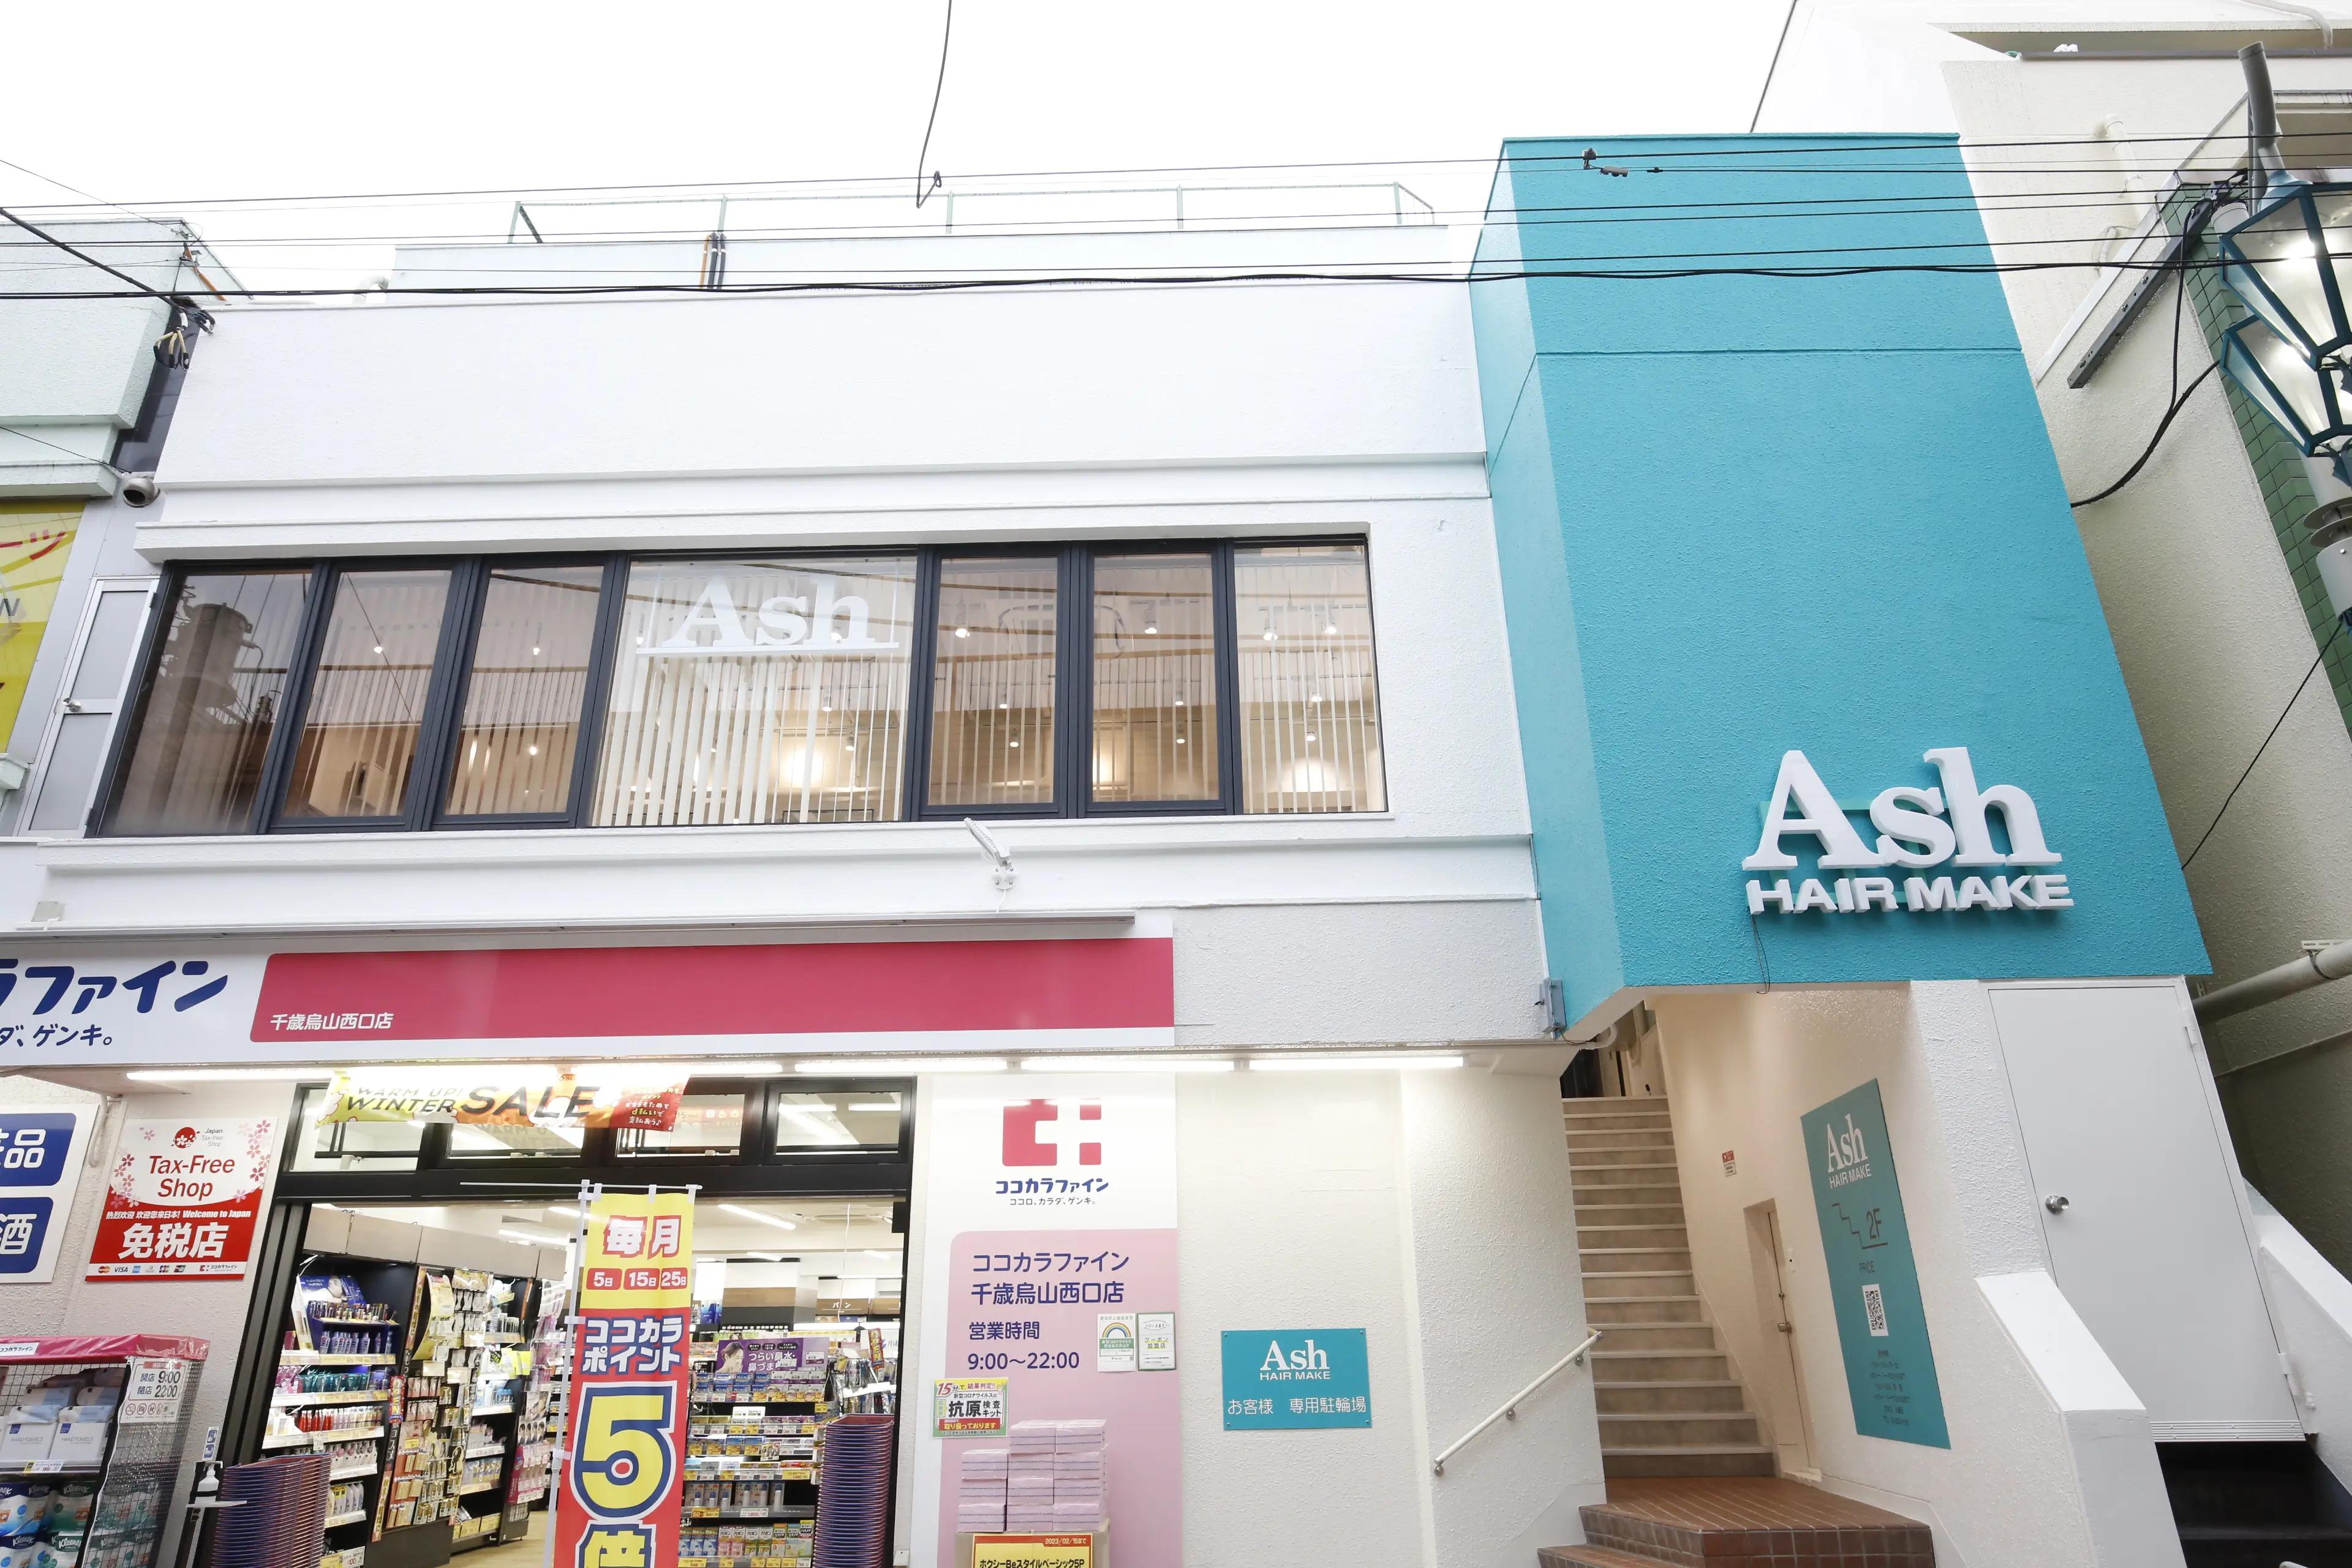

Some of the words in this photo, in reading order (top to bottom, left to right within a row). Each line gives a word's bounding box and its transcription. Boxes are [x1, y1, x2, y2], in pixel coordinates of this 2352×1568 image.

[662, 574, 876, 647] Ash
[1742, 746, 2063, 870] Ash
[1746, 876, 1899, 915] HAIR
[1904, 874, 2075, 911] MAKE
[270, 1012, 394, 1031] 千歳烏山西口店
[358, 1087, 420, 1096] WARM
[347, 1096, 457, 1113] WINTER
[461, 1085, 601, 1119] SALE
[0, 1128, 46, 1169] 品
[1826, 1112, 1869, 1174] Ash
[149, 1155, 235, 1174] Tax-Free
[1829, 1169, 1849, 1188] HAIR
[1849, 1163, 1871, 1185] MAKE
[157, 1178, 213, 1201] Shop
[995, 1178, 1109, 1194] ココカラファイン
[1009, 1197, 1096, 1206] ココロ、カラダ、ゲンキ。
[182, 1210, 219, 1219] Welcome
[1865, 1207, 1882, 1240] 2F
[118, 1222, 229, 1259] 免税店
[605, 1217, 680, 1257] 毎月
[973, 1251, 1129, 1273] ココカラファイン
[1860, 1260, 1875, 1275] PRICE
[593, 1272, 613, 1287] 5日
[628, 1272, 657, 1287] 15日
[661, 1270, 687, 1287] 25日
[971, 1281, 1125, 1305] 千歳烏山西口店
[585, 1317, 682, 1344] ココカラ
[969, 1321, 1040, 1340] 営業時間
[581, 1348, 682, 1373] ポイント
[1260, 1339, 1330, 1371] Ash
[158, 1371, 181, 1384] 9:00
[1260, 1372, 1292, 1381] HAIR
[1295, 1371, 1331, 1380] MAKE
[154, 1385, 178, 1397] 22:00
[948, 1400, 982, 1418] 抗原
[982, 1400, 1001, 1409] 検査
[1227, 1398, 1274, 1415] お客様
[1289, 1396, 1366, 1414] 専用駐輪場
[575, 1385, 673, 1518] 5
[63, 1484, 90, 1494] Kleenex
[13, 1535, 35, 1546] Kleenex
